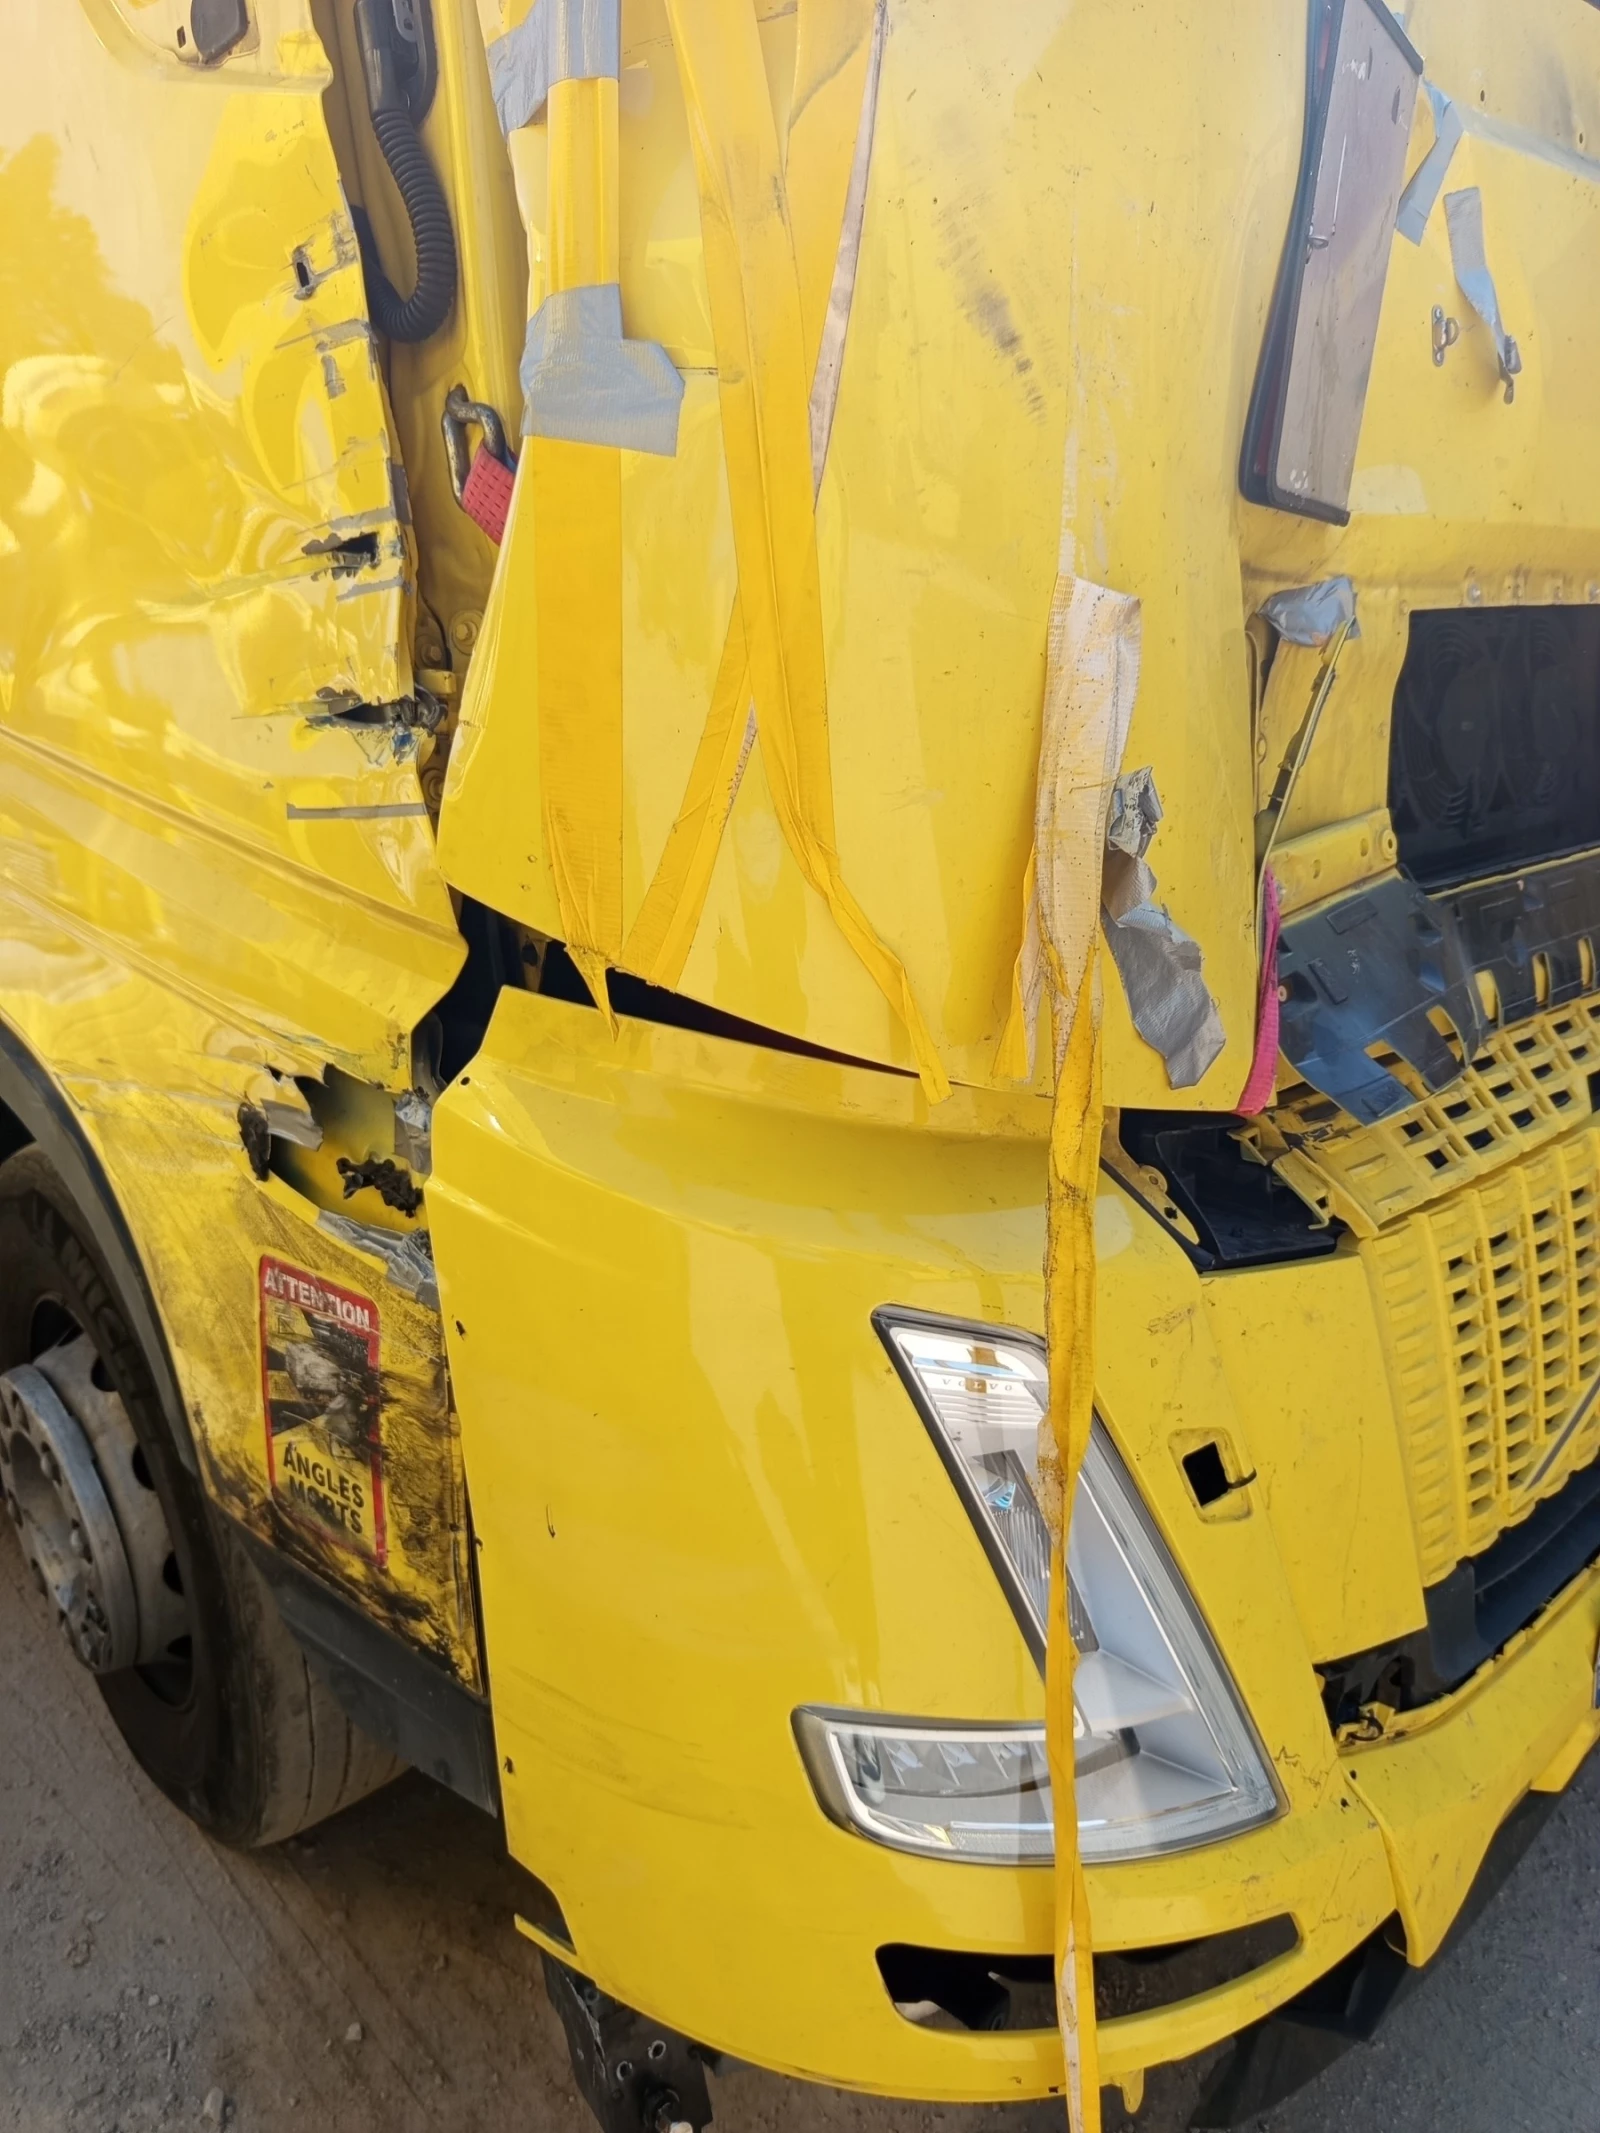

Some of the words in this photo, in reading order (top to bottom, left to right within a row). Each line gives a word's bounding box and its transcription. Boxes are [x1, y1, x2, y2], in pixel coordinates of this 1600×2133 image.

[264, 1267, 370, 1332] ATTENTION
[942, 1378, 1013, 1391] VOLVO
[283, 1443, 365, 1508] ANGLES
